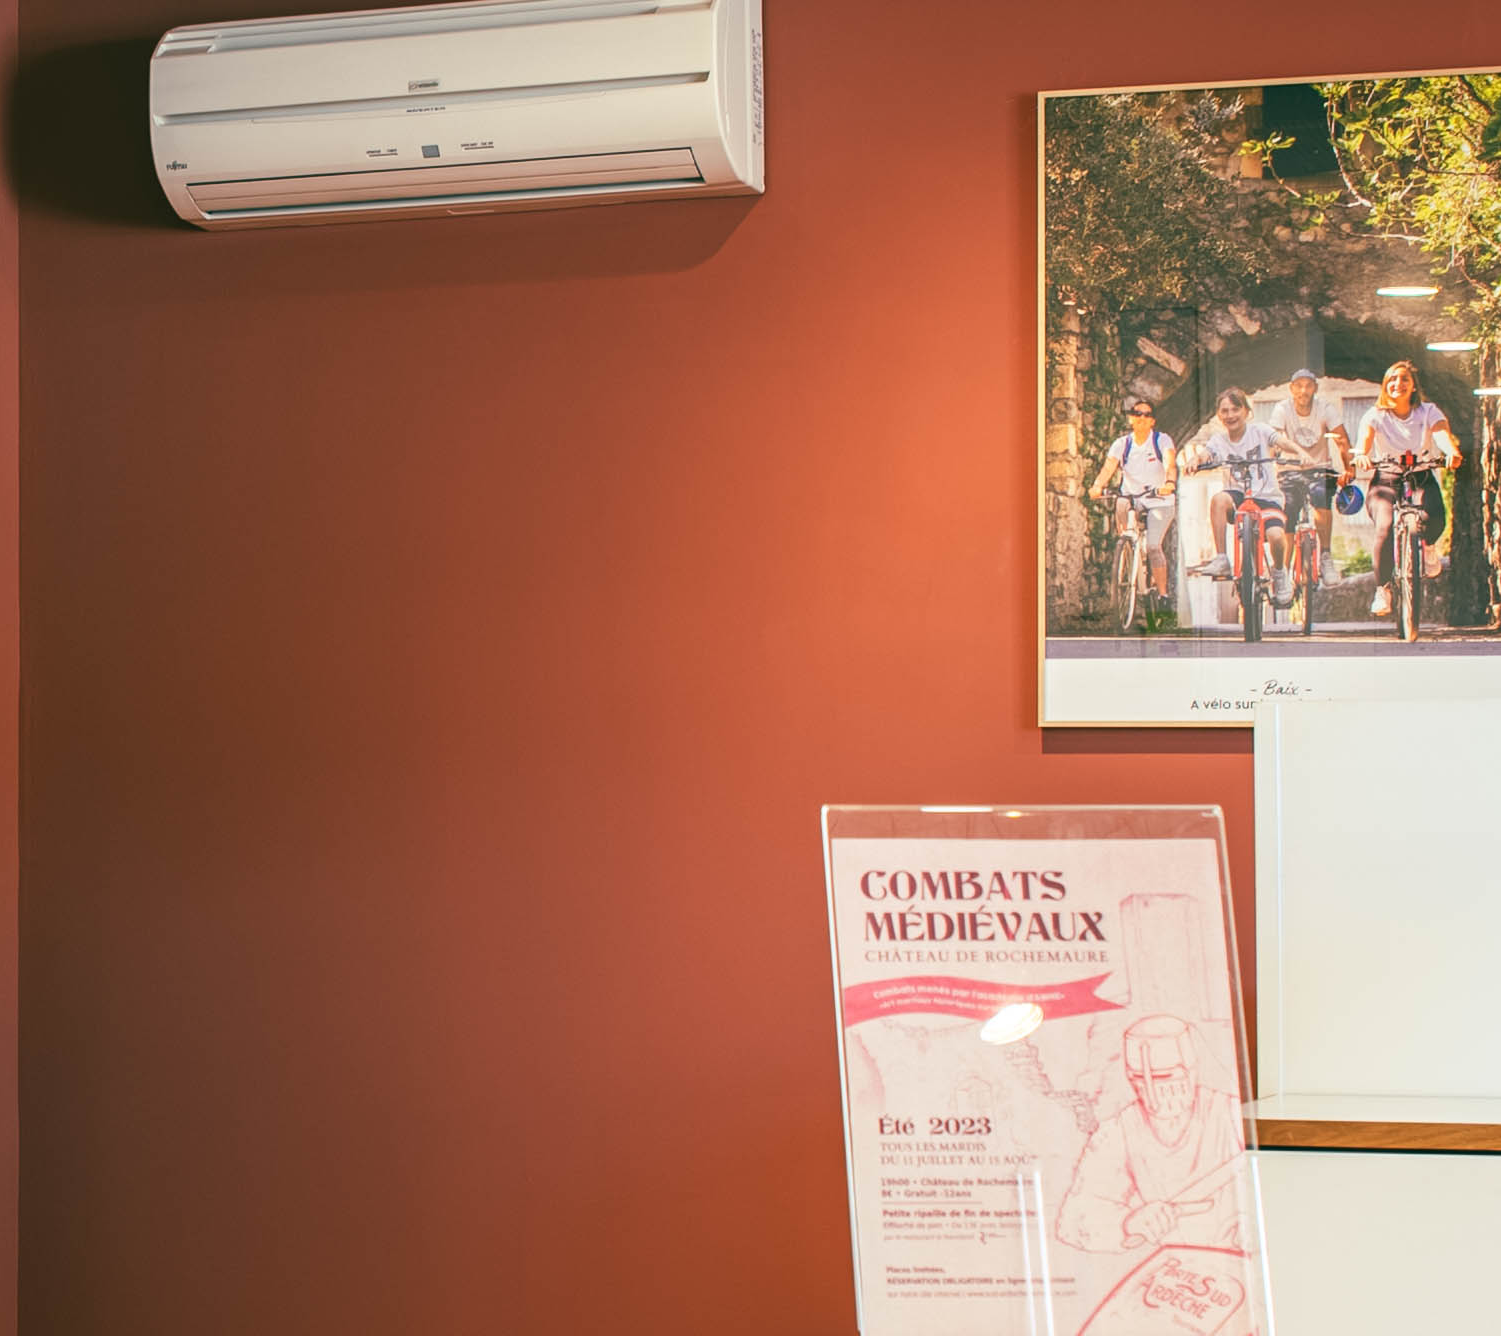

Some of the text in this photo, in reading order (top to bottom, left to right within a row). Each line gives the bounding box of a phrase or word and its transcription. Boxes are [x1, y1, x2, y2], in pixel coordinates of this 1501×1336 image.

[1262, 679, 1300, 698] Baix
[1191, 697, 1256, 710] A vélo sur
[860, 869, 1067, 902] COMBATS
[863, 904, 1108, 943] MÉDIÉVAUX
[864, 948, 1110, 964] CHÂTEAU DE ROCHEMAURE
[872, 984, 970, 1000] Combats menés par
[878, 1113, 993, 1137] Été 2023
[880, 1141, 988, 1153] TOUS LES MARDIS
[880, 1154, 988, 1168] DU JUILLET AU
[920, 1176, 960, 1187] Château
[962, 1177, 975, 1187] de
[904, 1188, 937, 1199] Gratuit
[882, 1209, 911, 1219] Petite
[949, 1209, 961, 1219] de
[964, 1209, 976, 1219] fin
[979, 1210, 991, 1219] de
[886, 1275, 994, 1285] RÉSERVATION OBLIGATOIRE
